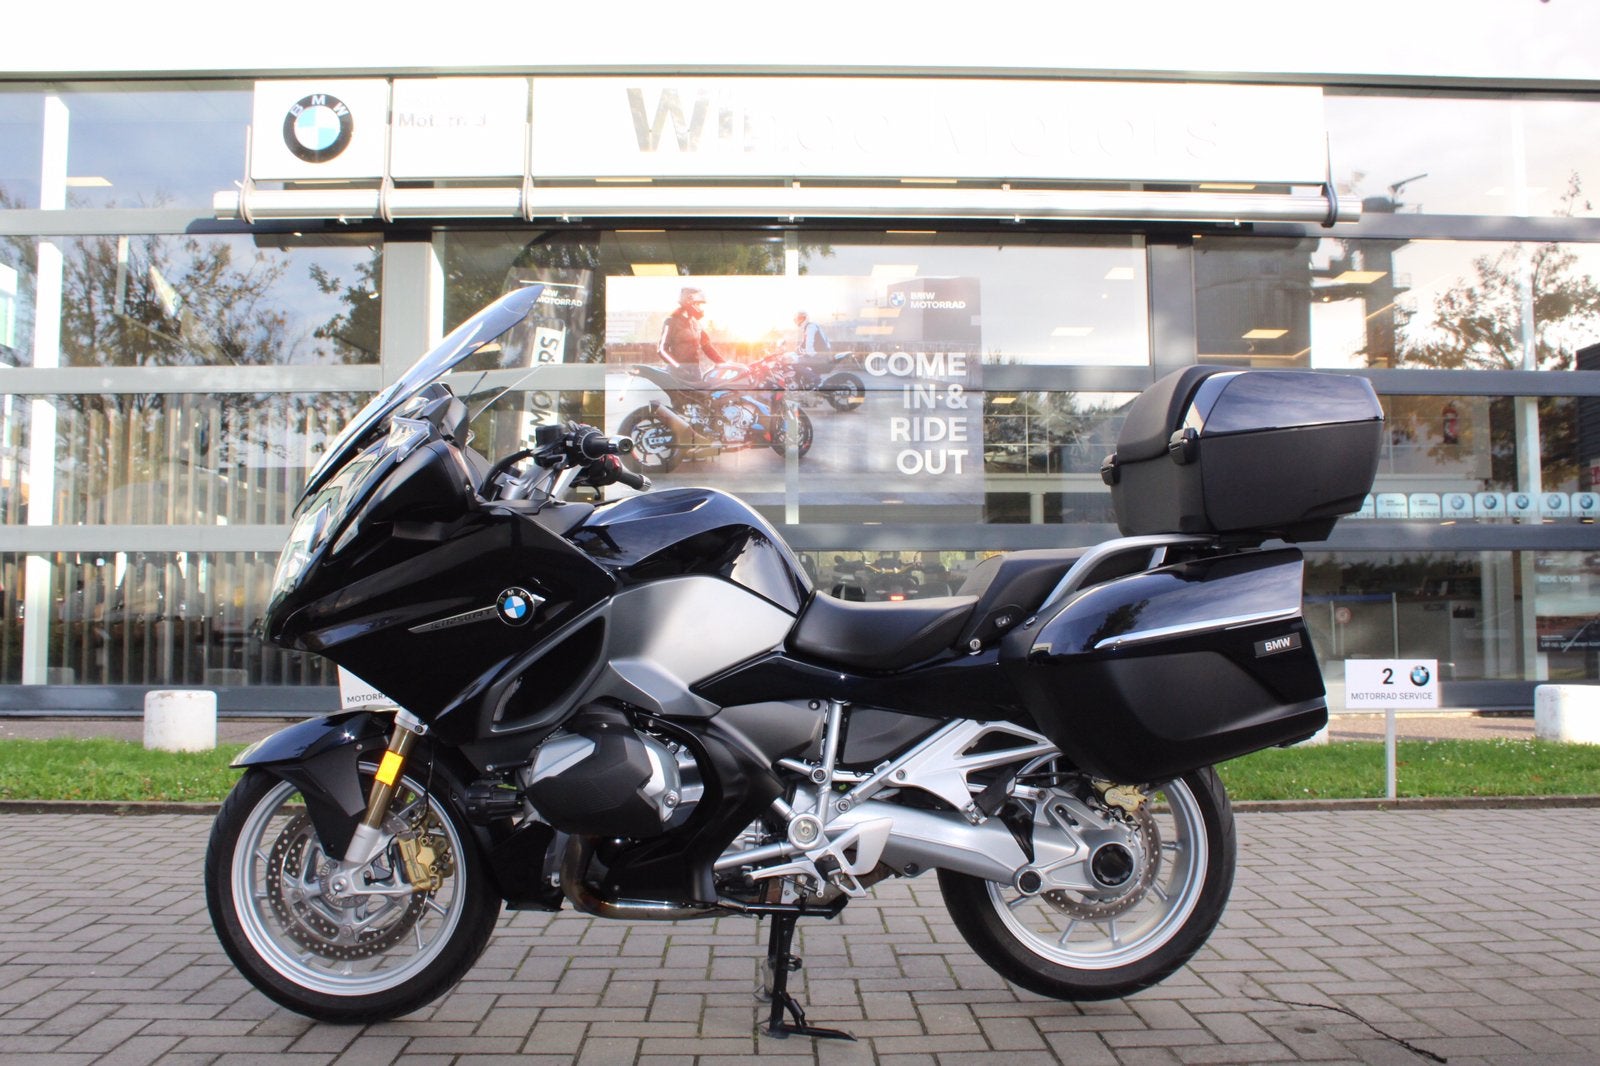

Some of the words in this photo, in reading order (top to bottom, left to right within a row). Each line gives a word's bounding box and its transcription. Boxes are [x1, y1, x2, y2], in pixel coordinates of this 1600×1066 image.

[290, 94, 349, 117] BMW
[398, 112, 486, 128] Motrrd
[910, 292, 936, 300] BMW
[910, 300, 966, 309] MOTORRAD
[864, 352, 966, 377] COME
[530, 335, 559, 427] MORS
[903, 383, 936, 409] IN
[945, 383, 968, 409] &
[890, 416, 968, 442] RIDE
[896, 449, 968, 475] OUT
[1264, 637, 1291, 652] BMW
[1382, 667, 1394, 685] 2
[347, 693, 387, 703] MOTORR
[1351, 692, 1397, 700] MOTORRAD
[1399, 692, 1432, 700] SERVICE
